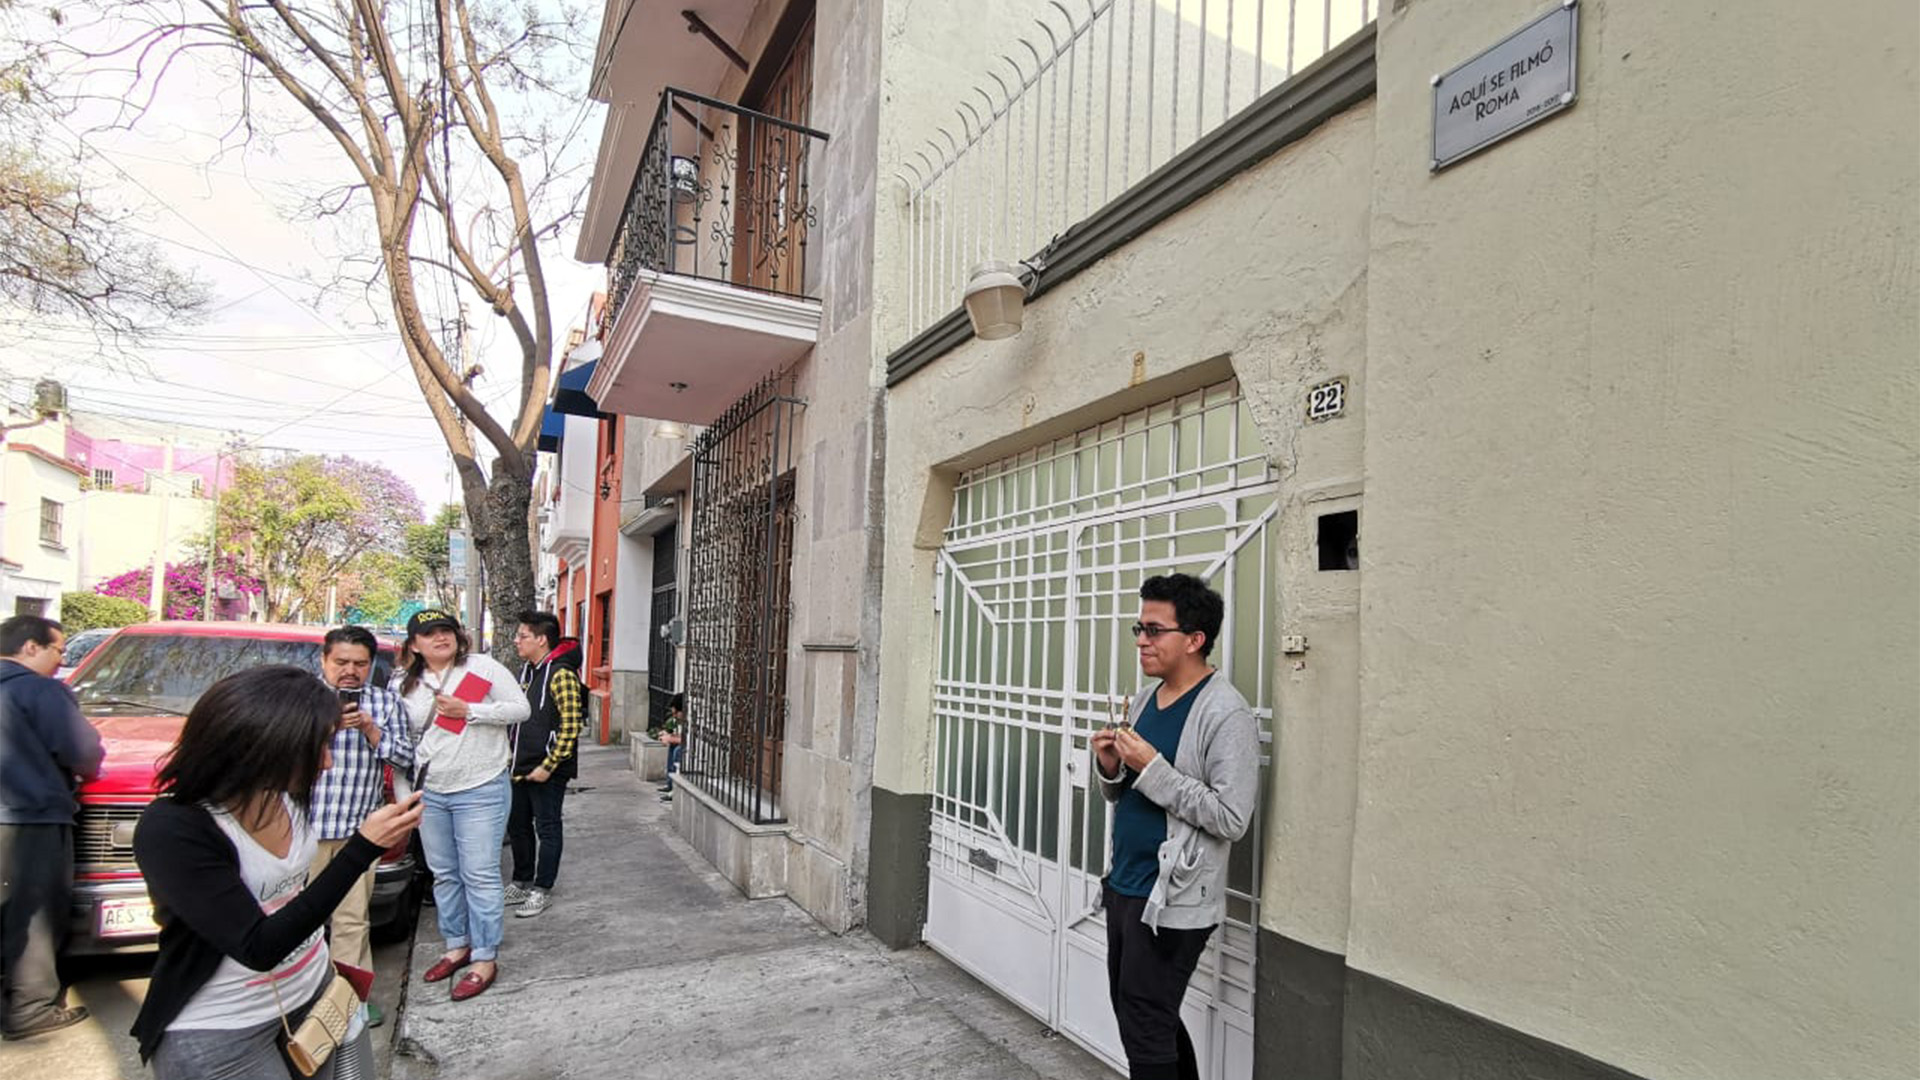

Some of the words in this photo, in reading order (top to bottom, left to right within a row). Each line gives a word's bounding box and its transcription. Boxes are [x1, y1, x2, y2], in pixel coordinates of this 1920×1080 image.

[1449, 75, 1486, 114] AQUÍ
[1490, 70, 1505, 92] SE
[1510, 40, 1554, 81] FILMÓ
[1475, 87, 1520, 121] ROMA
[1313, 387, 1338, 414] 22
